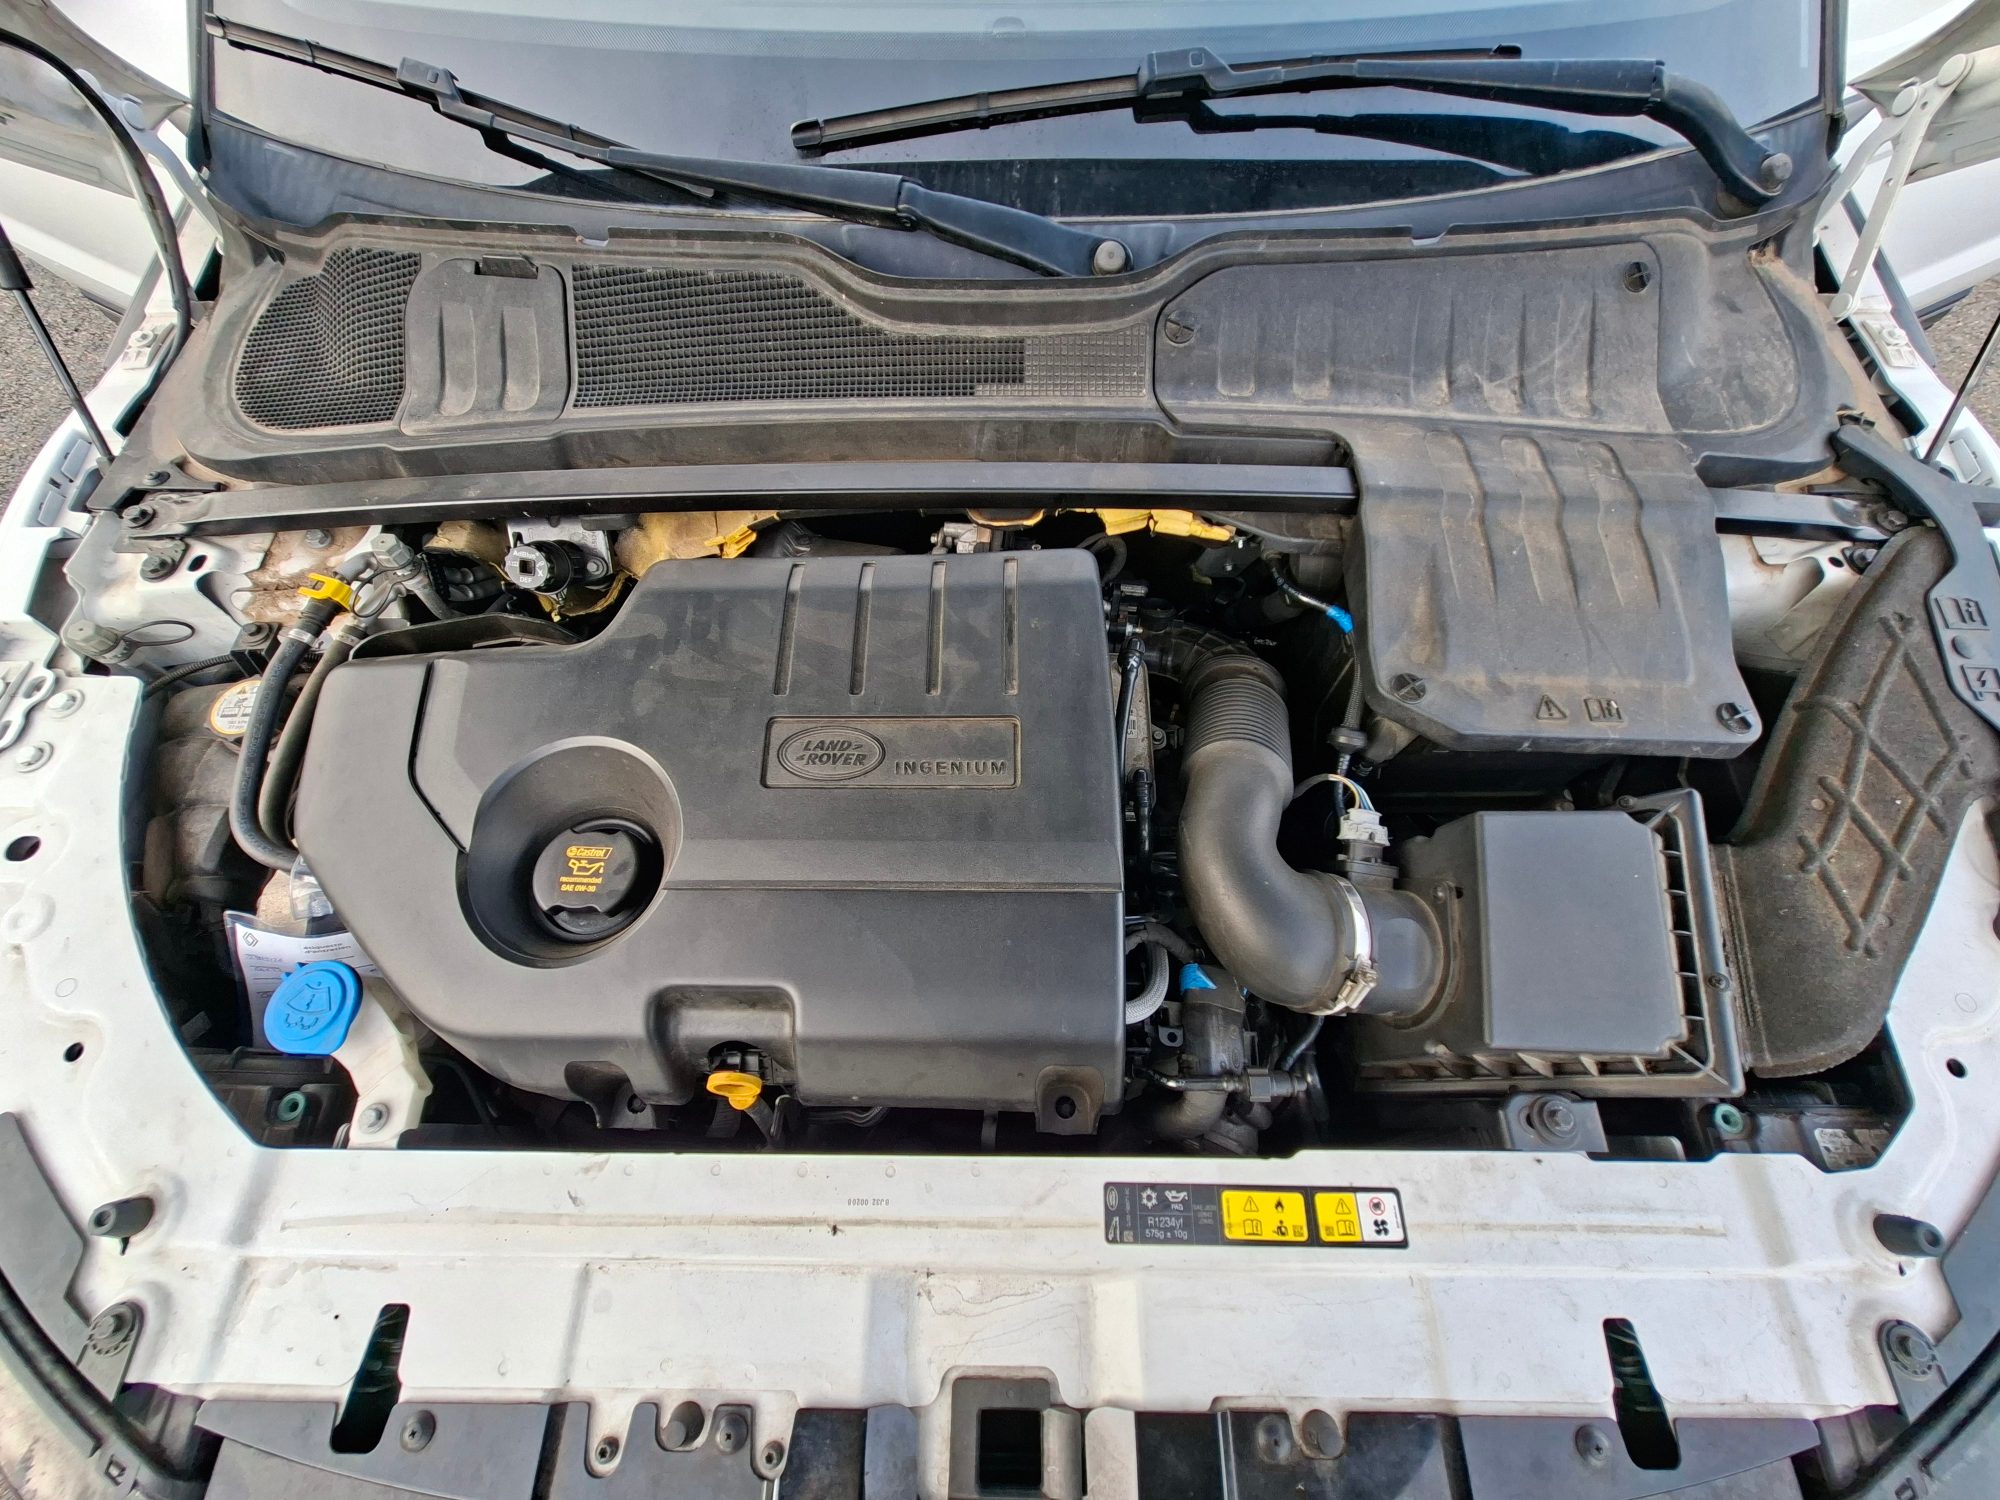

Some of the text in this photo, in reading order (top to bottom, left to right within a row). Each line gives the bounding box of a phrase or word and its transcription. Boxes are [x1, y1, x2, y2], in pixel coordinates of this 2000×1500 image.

[803, 739, 851, 751] LAND
[803, 753, 868, 766] ROVER
[895, 761, 1007, 776] INGENIUM
[576, 847, 605, 857] Castrol
[560, 876, 602, 884] recommended
[1147, 1216, 1183, 1230] R1234yf
[1145, 1229, 1165, 1240] 575g
[1174, 1230, 1188, 1240] 10g
